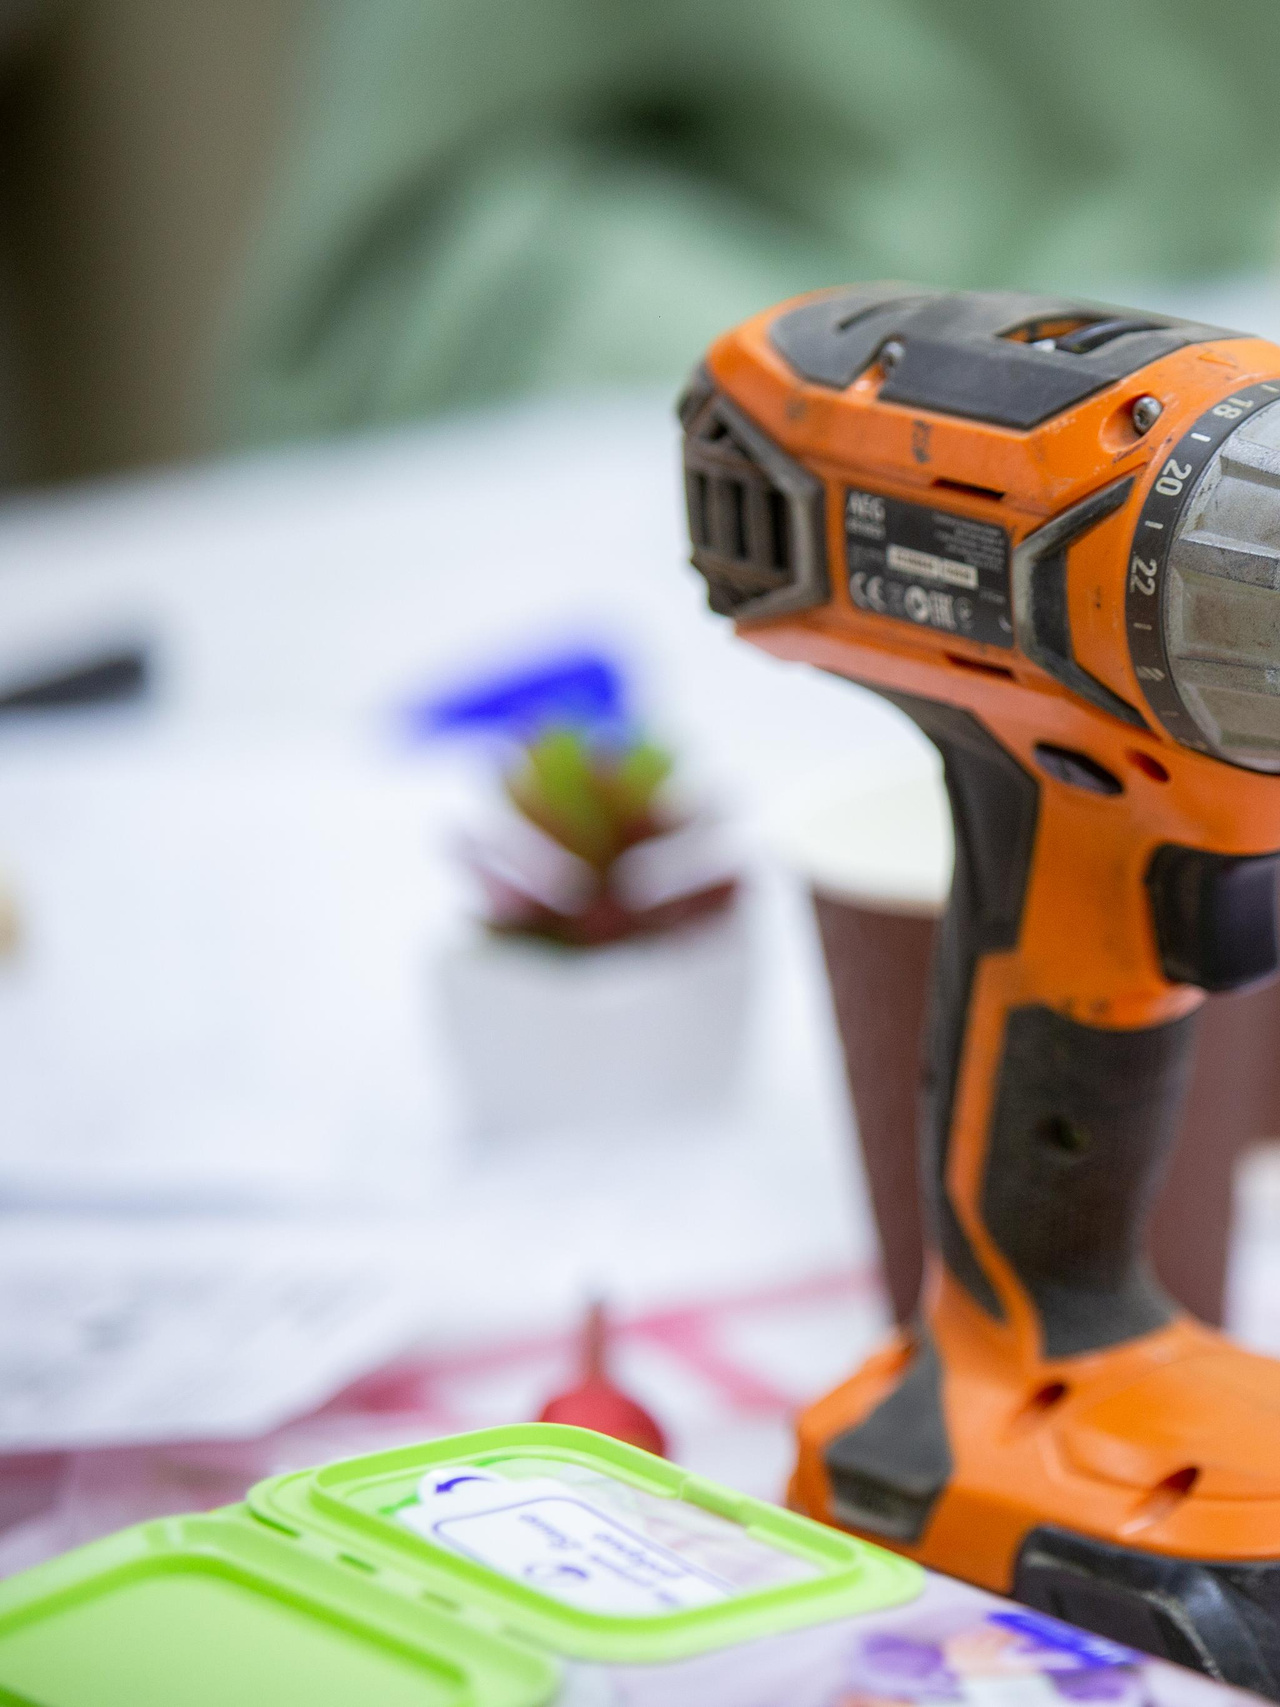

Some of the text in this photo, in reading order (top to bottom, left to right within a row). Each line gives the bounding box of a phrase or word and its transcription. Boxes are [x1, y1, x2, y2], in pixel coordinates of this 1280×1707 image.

[1212, 397, 1254, 420] 18
[1155, 458, 1193, 496] 20
[847, 491, 886, 521] AEG
[1130, 555, 1157, 597] 22
